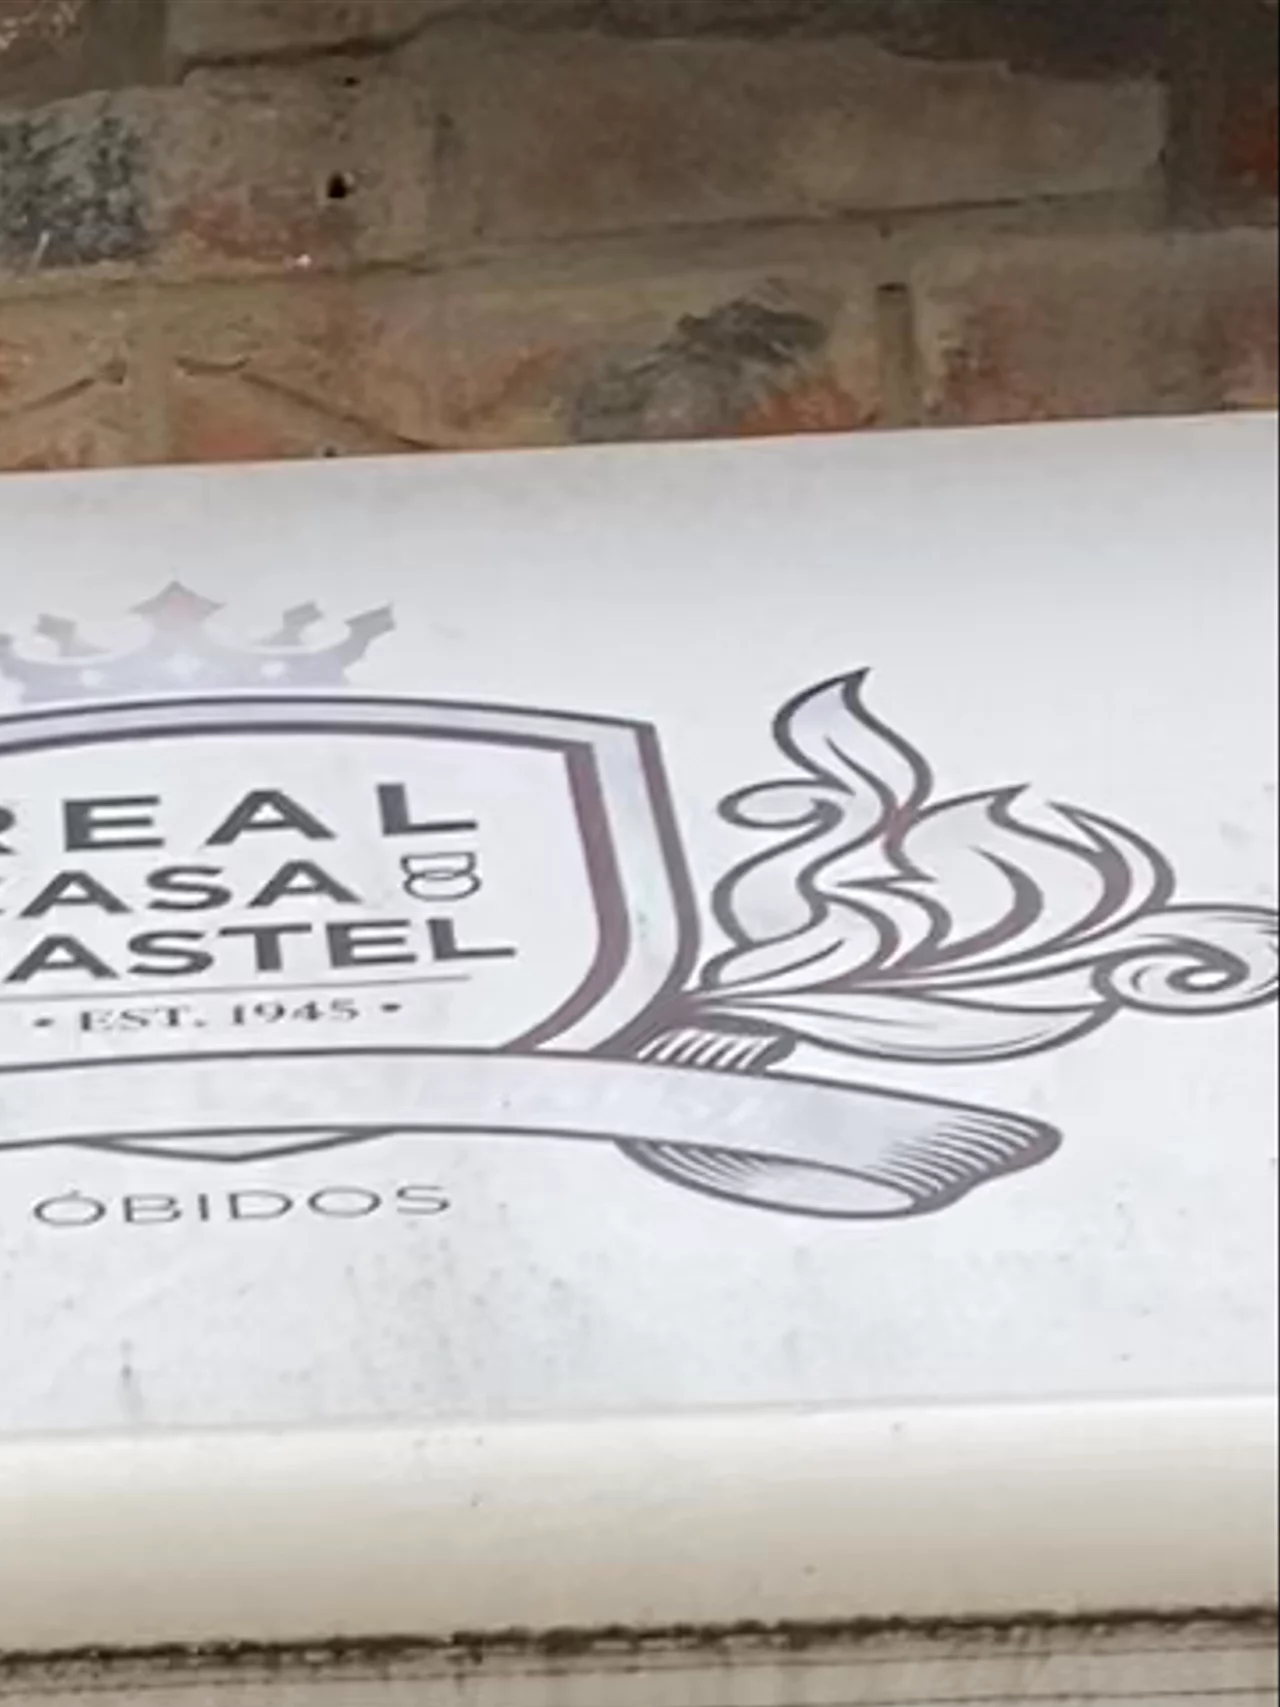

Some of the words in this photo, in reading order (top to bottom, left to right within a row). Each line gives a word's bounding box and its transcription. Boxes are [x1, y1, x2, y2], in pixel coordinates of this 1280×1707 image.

[80, 1005, 207, 1032] EST.
[231, 998, 359, 1026] 1945
[33, 1185, 451, 1227] ÓBIDOS
